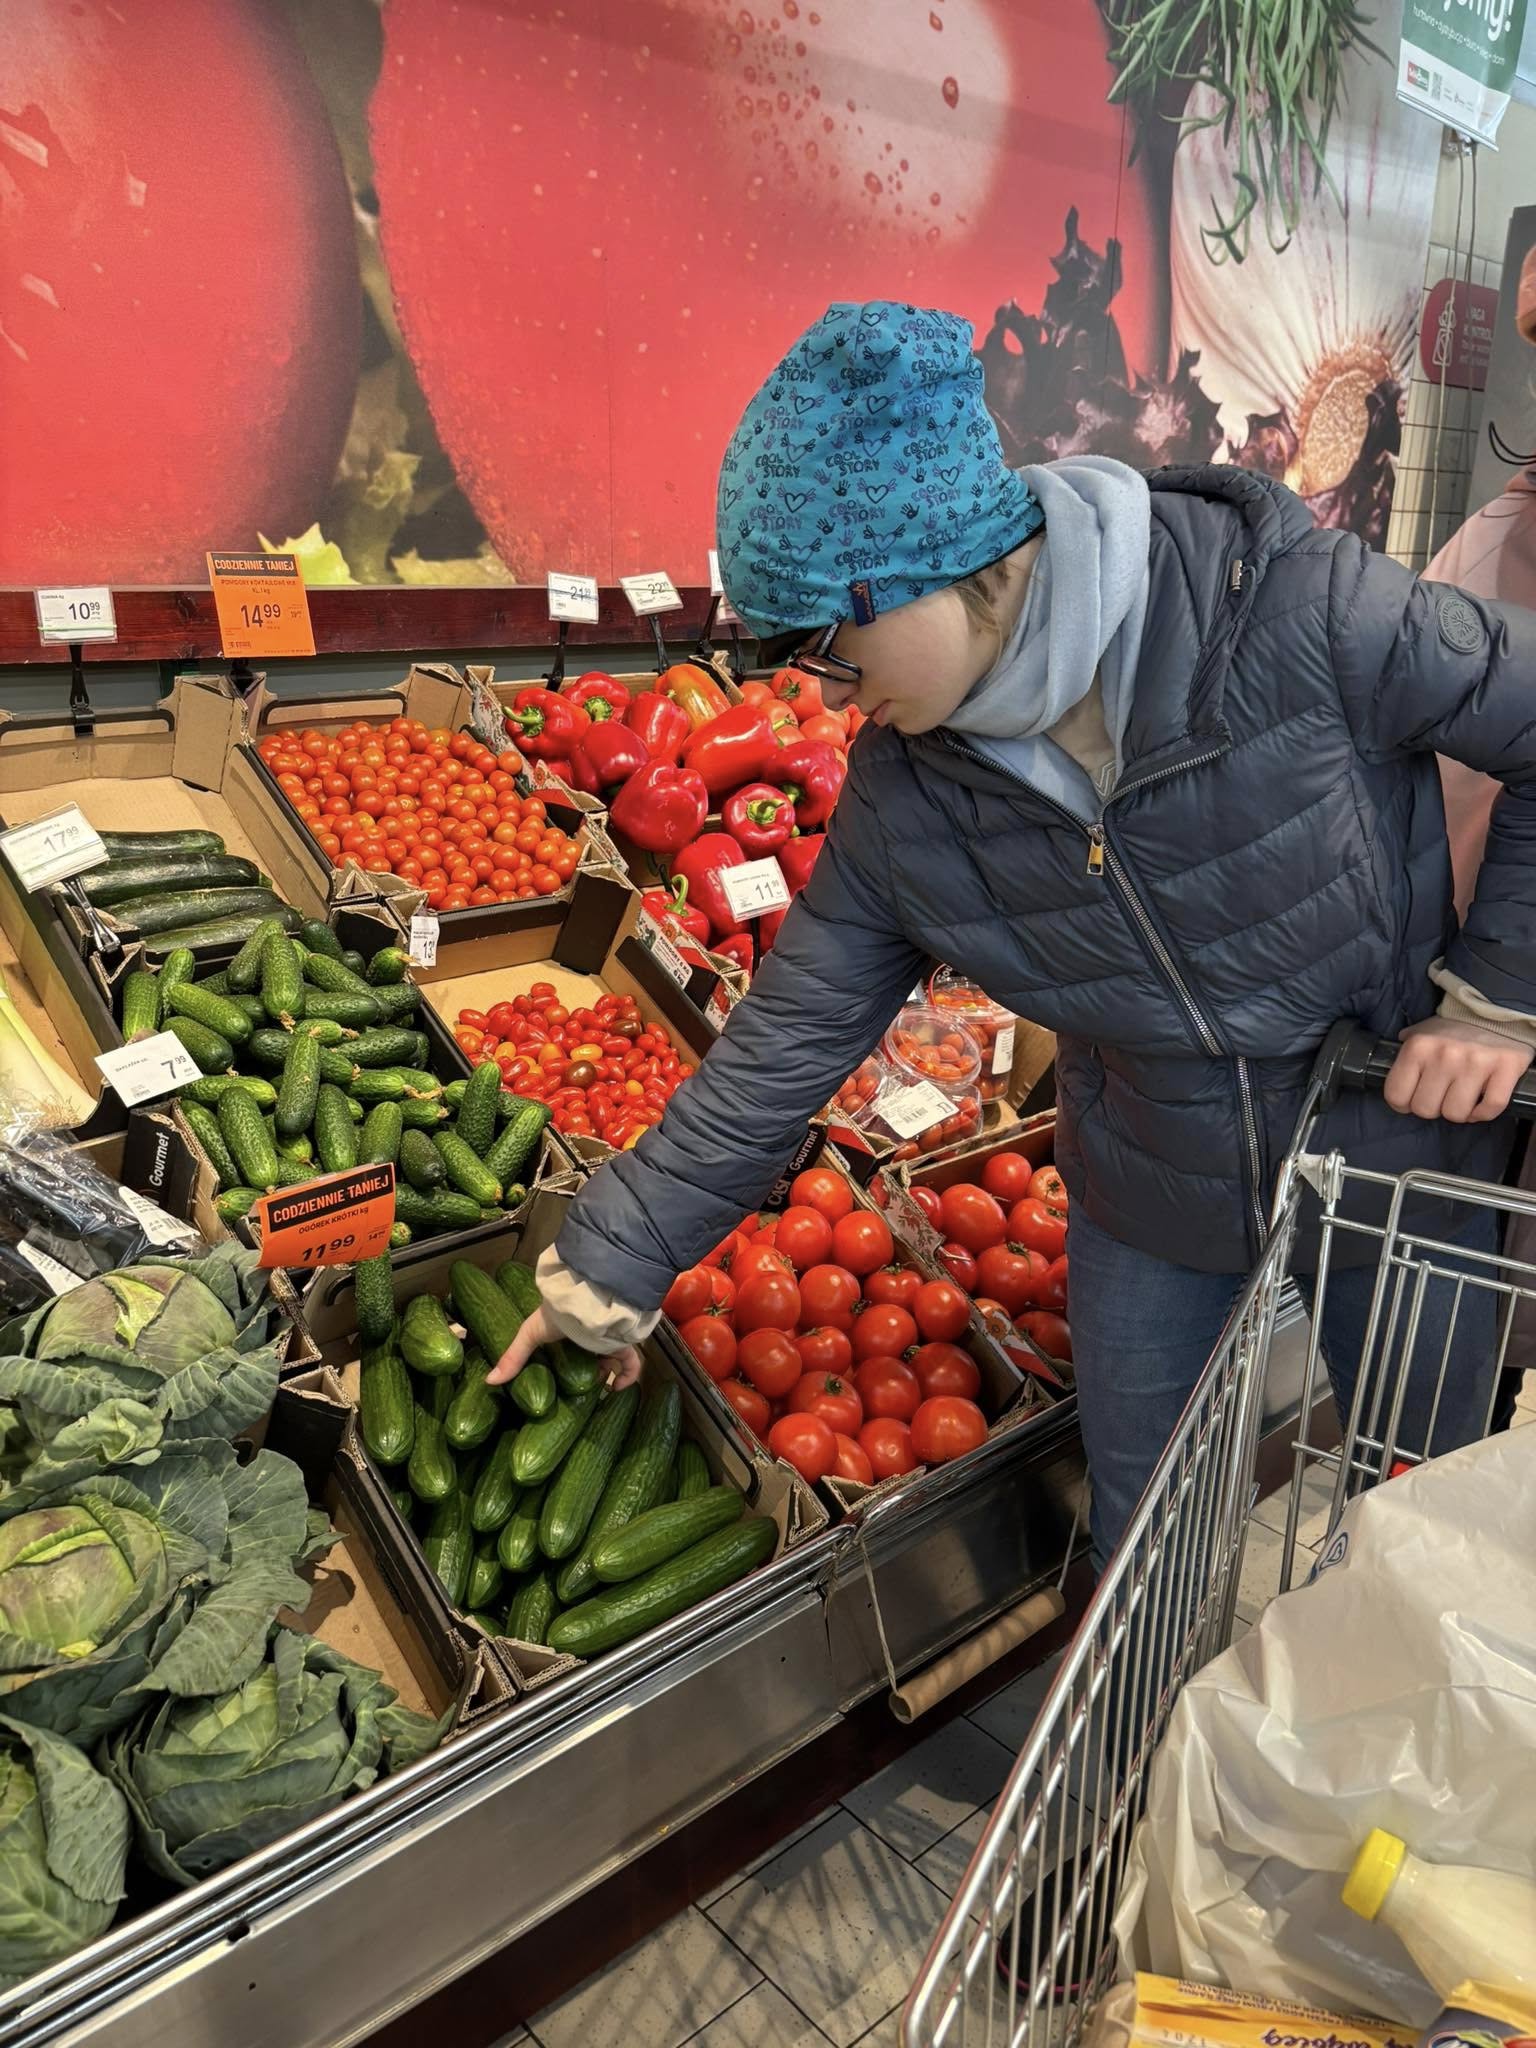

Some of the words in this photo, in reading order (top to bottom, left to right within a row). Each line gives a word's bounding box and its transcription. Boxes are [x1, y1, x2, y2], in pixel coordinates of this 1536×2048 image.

[911, 359, 940, 373] COOL
[777, 369, 817, 384] STORY
[848, 371, 889, 391] STORY
[764, 405, 792, 420] COOL
[903, 438, 935, 457] COOL
[915, 442, 950, 465] STORY
[755, 453, 784, 468] COOL
[825, 450, 862, 468] COOL
[839, 459, 880, 477] STORY
[762, 463, 801, 478] STORY
[911, 483, 944, 501] COOL
[924, 487, 961, 509] STORY
[750, 503, 783, 521] COOL
[827, 499, 866, 519] COOL
[843, 506, 886, 526] STORY
[760, 515, 803, 533] STORY
[214, 559, 264, 571] CODZIENNIE
[265, 560, 294, 571] TANIEJ
[750, 557, 789, 576] COOL
[834, 547, 872, 567] COOL
[847, 553, 890, 576] STORY
[149, 1132, 170, 1187] Gourmet
[789, 1130, 819, 1171] Gourmet
[273, 1189, 346, 1223] CODZIENNIE
[347, 1174, 389, 1198] TANIEJ
[298, 1219, 331, 1234] OGÓREK
[331, 1209, 359, 1224] KRÓTKI
[359, 1206, 369, 1215] kg
